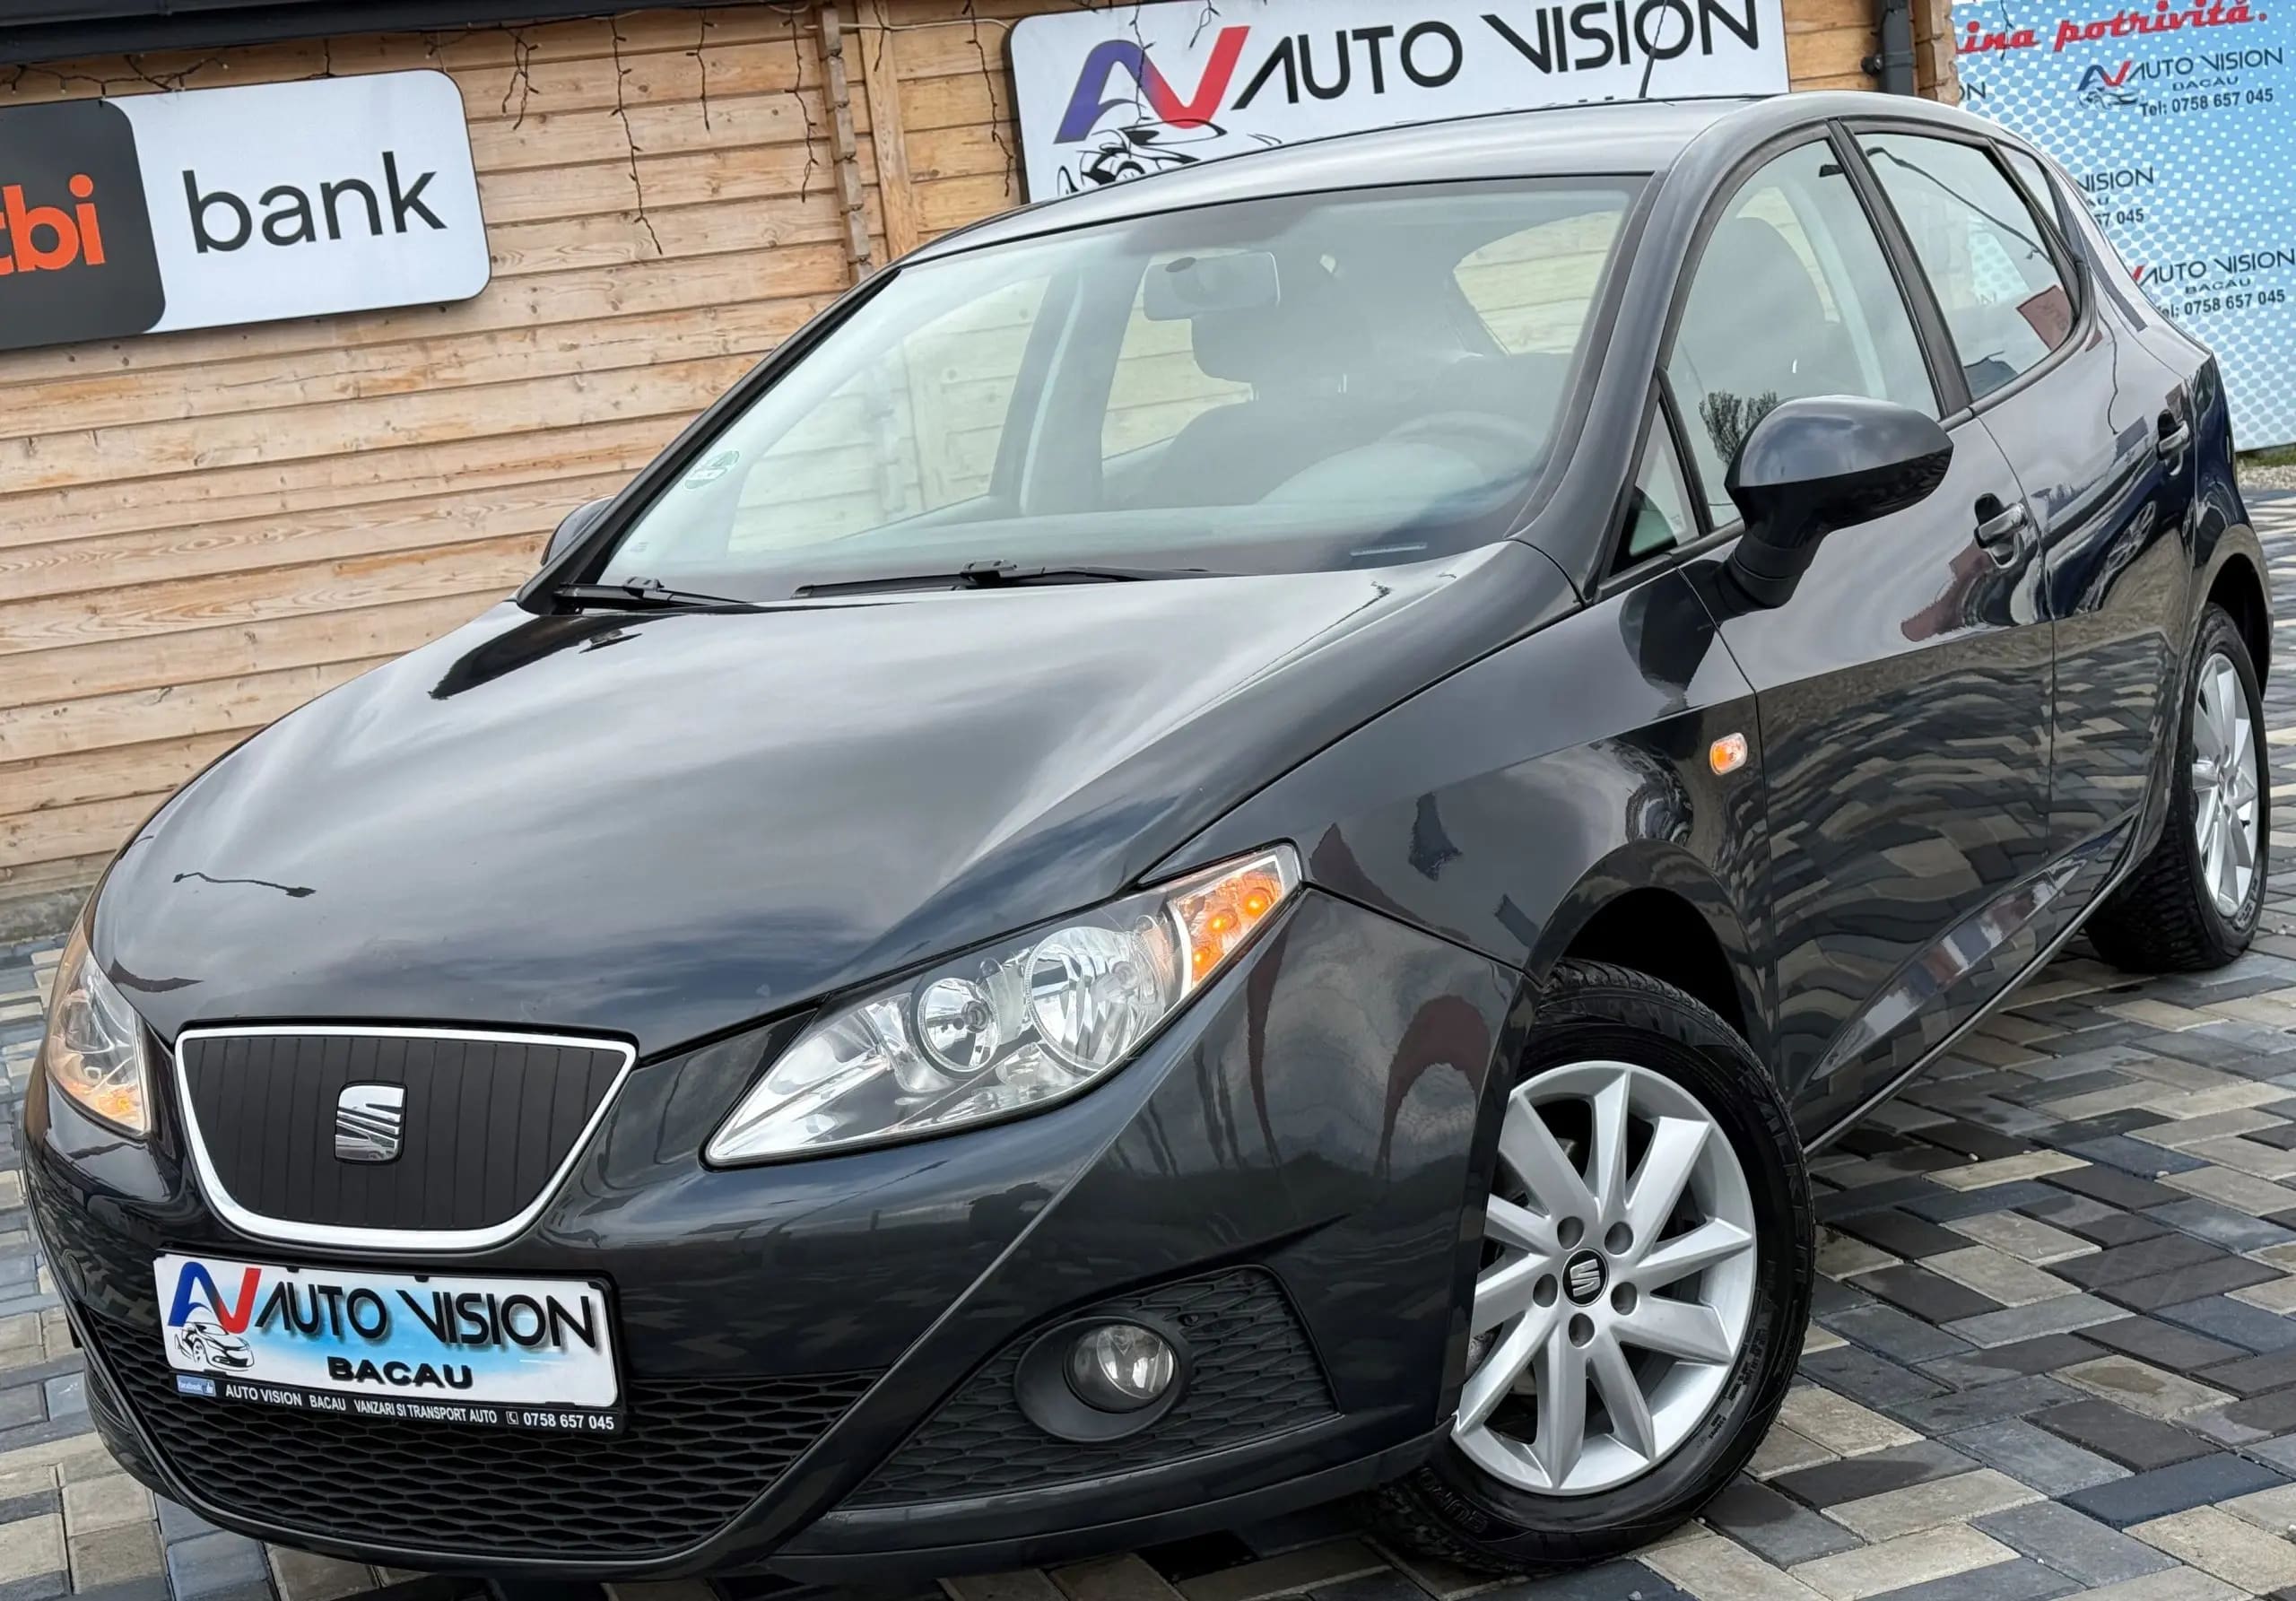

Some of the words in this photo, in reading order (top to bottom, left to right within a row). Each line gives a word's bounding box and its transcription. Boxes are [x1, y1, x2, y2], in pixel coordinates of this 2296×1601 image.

[1231, 21, 1464, 111] AUTO
[1480, 0, 1759, 74] VISION
[2126, 57, 2194, 81] AUTO
[2200, 48, 2283, 72] VISION
[2139, 100, 2168, 117] Tel:
[2171, 96, 2209, 113] 0758
[2213, 91, 2241, 108] 657
[2246, 88, 2274, 104] 045
[2075, 165, 2154, 193] VISION
[183, 151, 447, 254] bank
[2117, 207, 2144, 224] 045
[2139, 261, 2207, 286] AUTO
[2213, 248, 2296, 274] VISION
[2184, 298, 2222, 316] 0758
[2226, 293, 2252, 309] 657
[2258, 290, 2285, 305] 045
[255, 1281, 387, 1340] AUTO
[396, 1289, 596, 1349] VISION
[326, 1355, 474, 1390] BACAU
[225, 1384, 258, 1401] AUTO
[260, 1388, 303, 1407] VISION
[309, 1394, 347, 1412] BACAU
[353, 1398, 396, 1416] VANZARI
[396, 1404, 407, 1417] SI
[406, 1404, 467, 1423] TRANSPORT
[469, 1409, 498, 1424] AUTO
[523, 1412, 557, 1428] 0758
[560, 1414, 585, 1429] 657
[588, 1415, 615, 1431] 045
